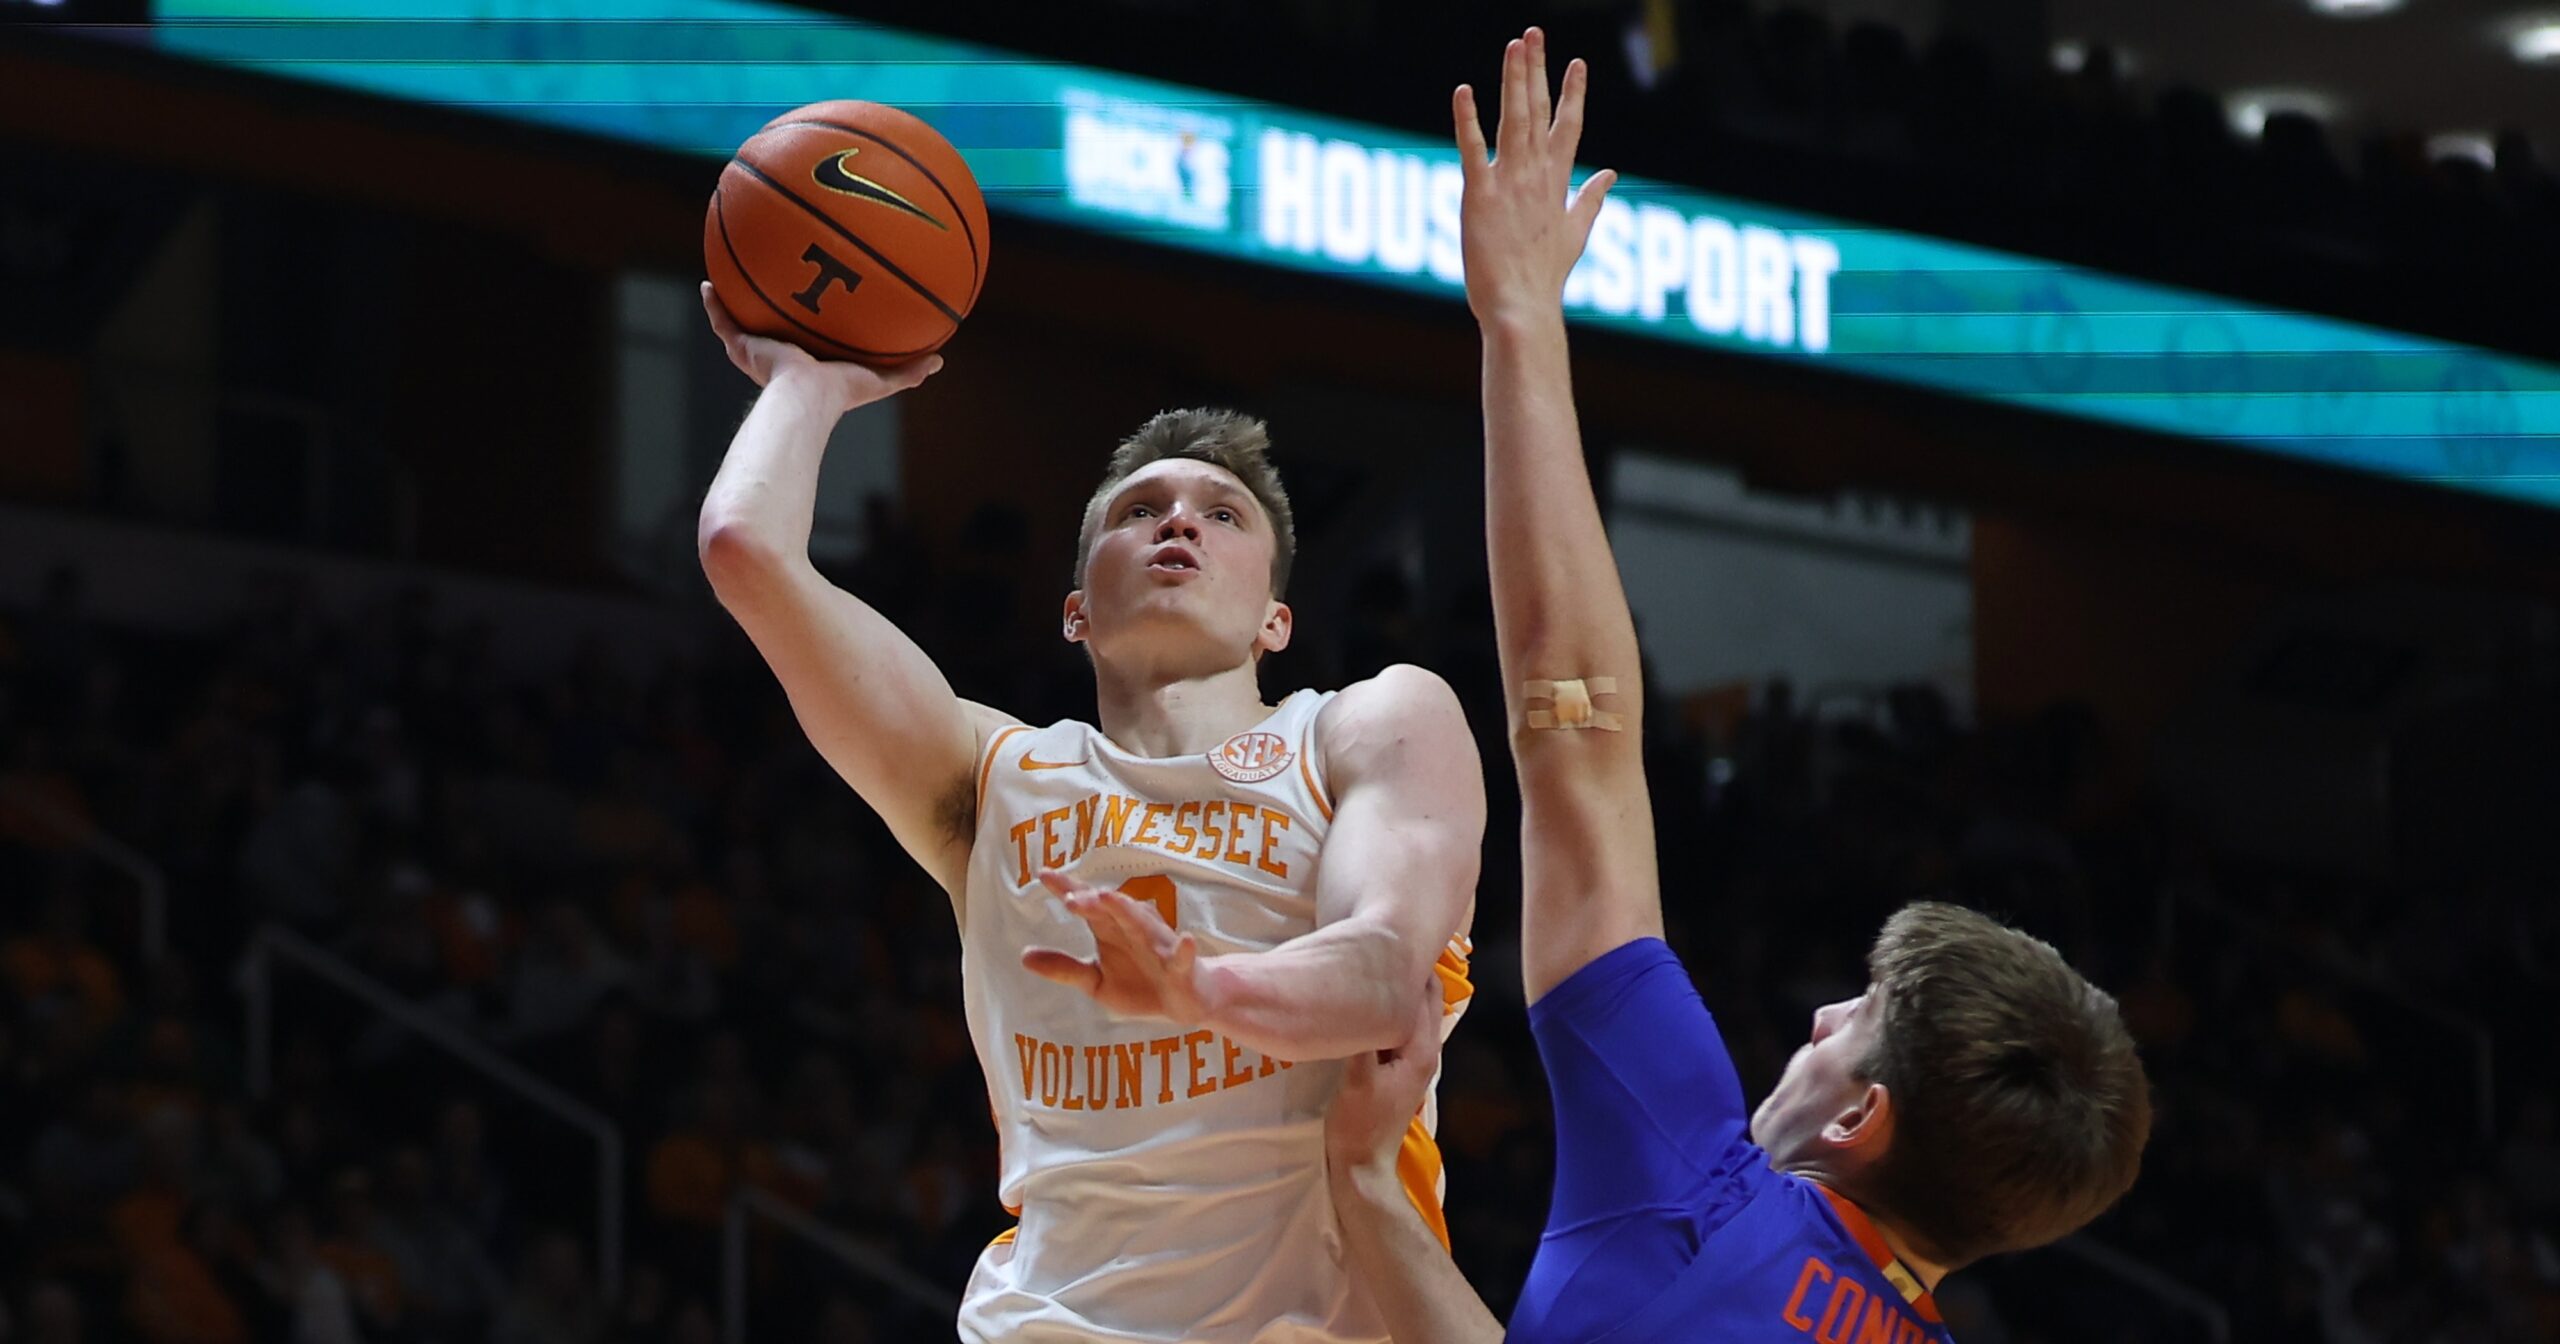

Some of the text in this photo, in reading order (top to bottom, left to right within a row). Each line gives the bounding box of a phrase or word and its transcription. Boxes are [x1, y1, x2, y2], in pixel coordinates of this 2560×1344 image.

[791, 243, 863, 315] T
[1260, 127, 1466, 286] HOUS
[1588, 194, 1840, 354] SPORT
[1228, 734, 1282, 768] SEC
[1010, 794, 1290, 889] TENNESSEE
[1014, 1029, 1293, 1110] VOLUNTEE
